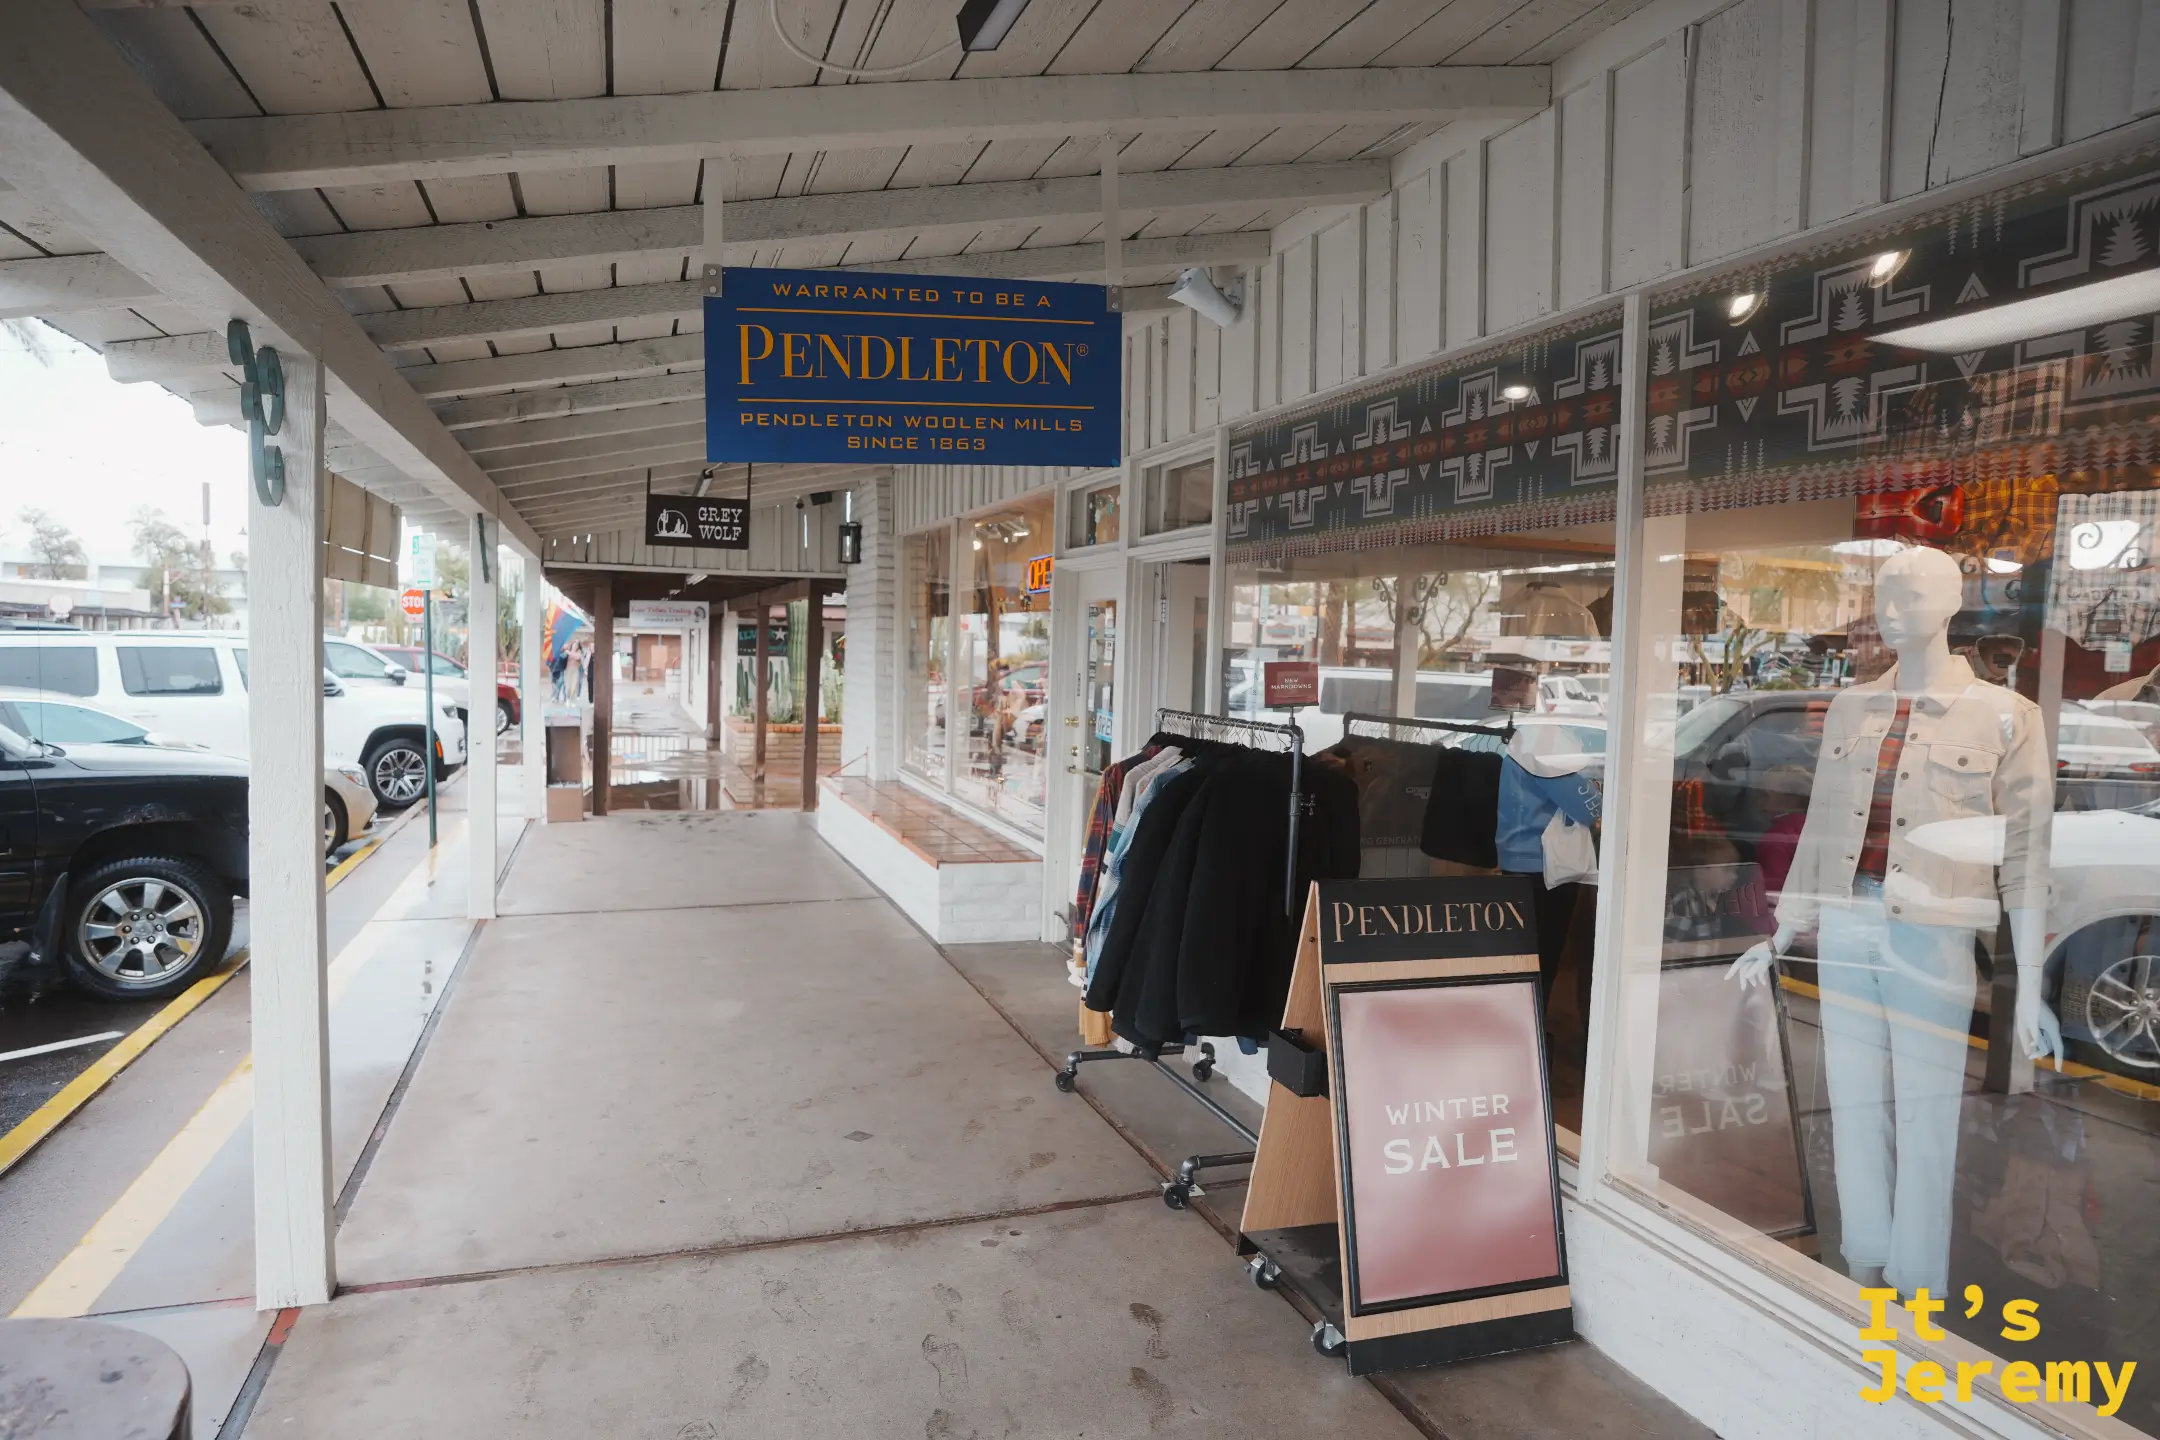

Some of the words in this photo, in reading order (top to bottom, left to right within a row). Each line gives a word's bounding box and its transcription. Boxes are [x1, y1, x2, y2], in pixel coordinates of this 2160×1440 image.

[772, 283, 940, 303] WARRANTED
[953, 290, 984, 304] TO
[995, 292, 1025, 307] BE
[1037, 295, 1051, 308] A
[740, 412, 892, 428] PENDLETON
[903, 415, 1004, 430] WOOLEN
[1014, 418, 1083, 432] MILLS
[846, 436, 919, 450] SINCE
[929, 437, 986, 451] 1863
[698, 506, 743, 523] GREY
[698, 524, 742, 541] WOLF
[1332, 902, 1525, 943] PENDLETON
[1384, 1094, 1509, 1126] WINTER
[1383, 1127, 1518, 1174] SALE
